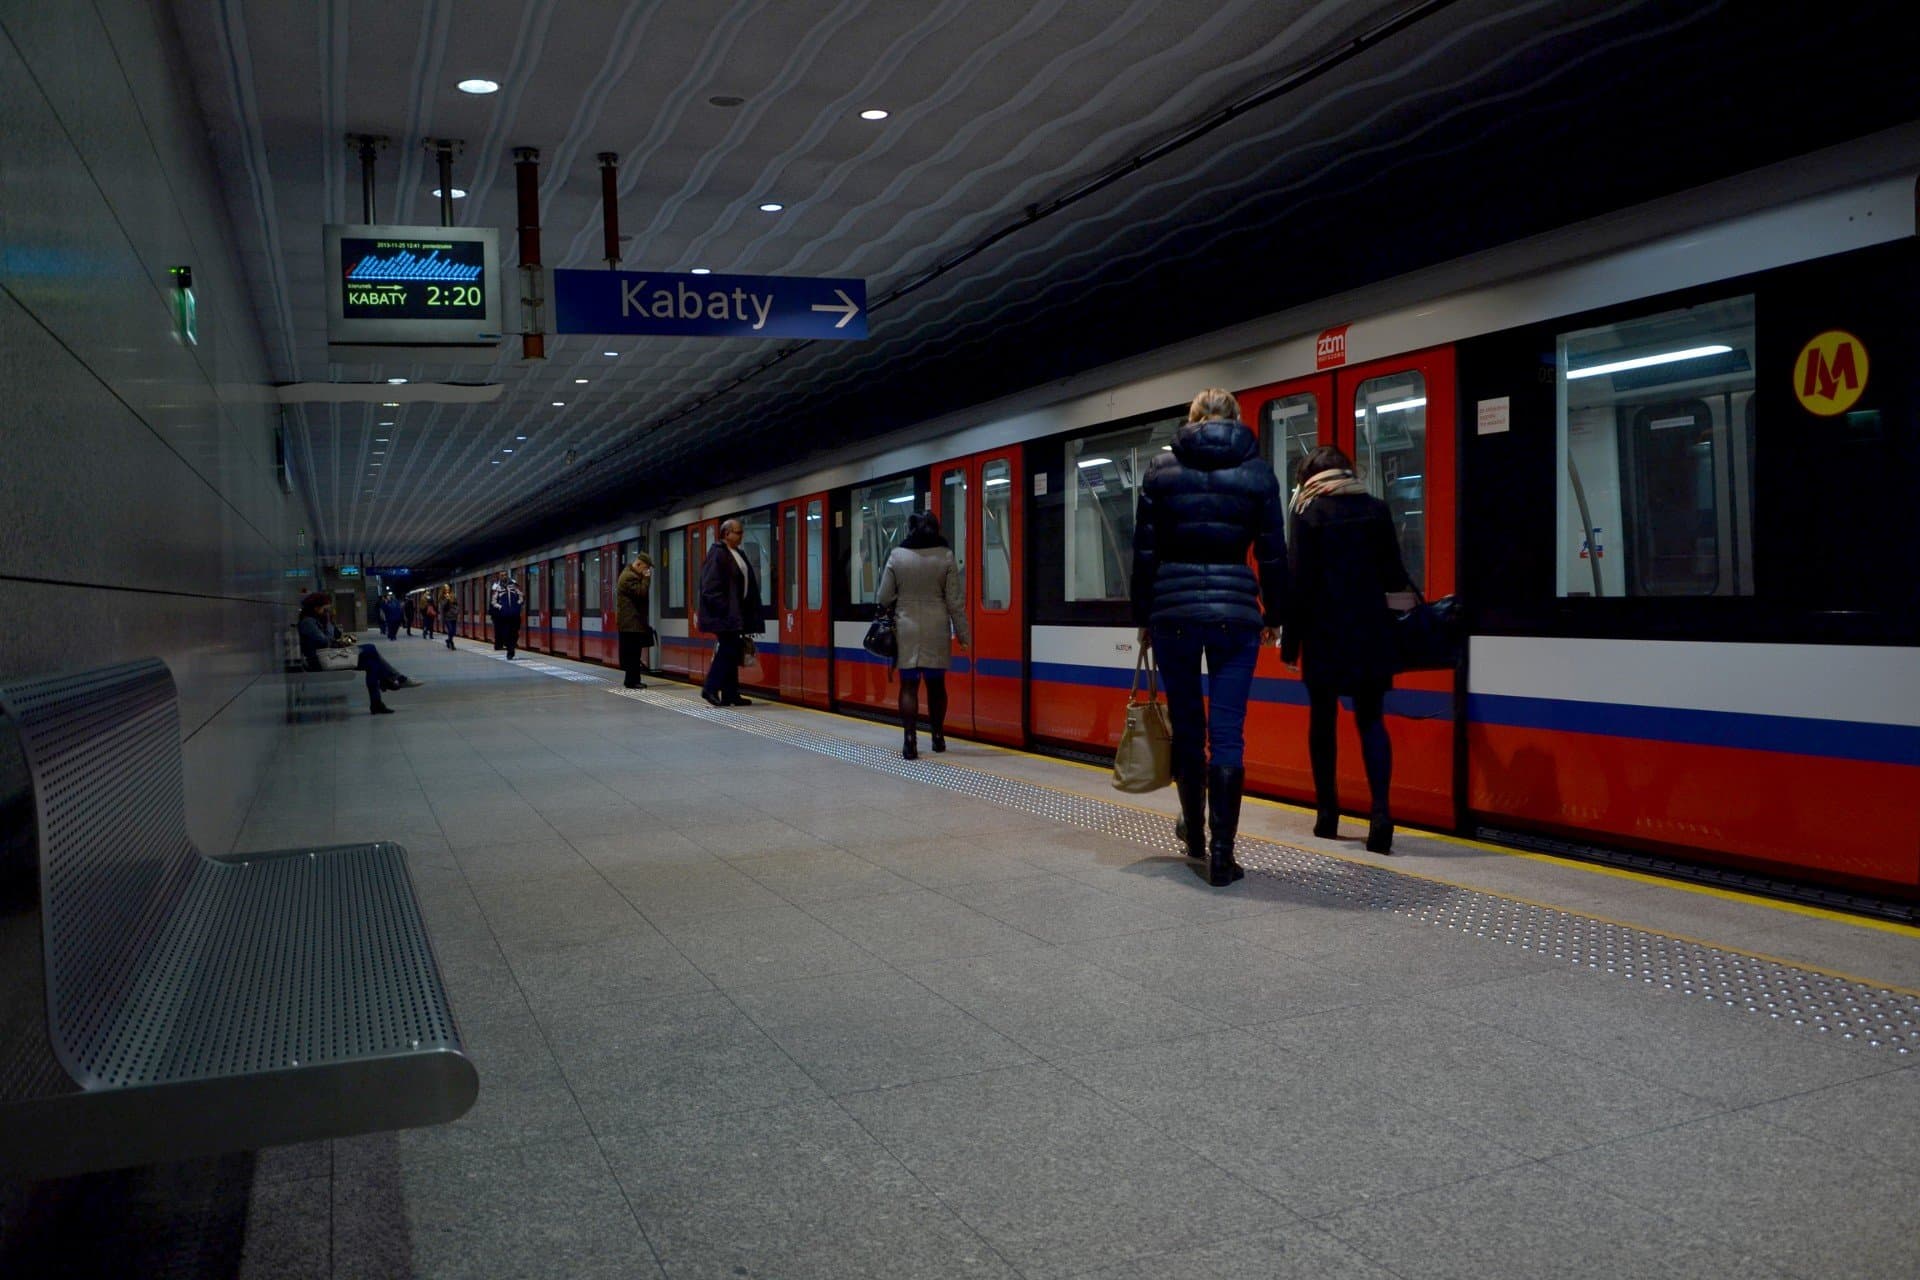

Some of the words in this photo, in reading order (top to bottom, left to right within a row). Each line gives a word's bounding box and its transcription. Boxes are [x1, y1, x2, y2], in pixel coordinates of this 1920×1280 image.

[349, 292, 407, 305] KABATY
[427, 286, 481, 306] 2:20
[620, 279, 775, 330] Kabaty
[1318, 334, 1345, 356] ztm
[1803, 342, 1859, 401] M
